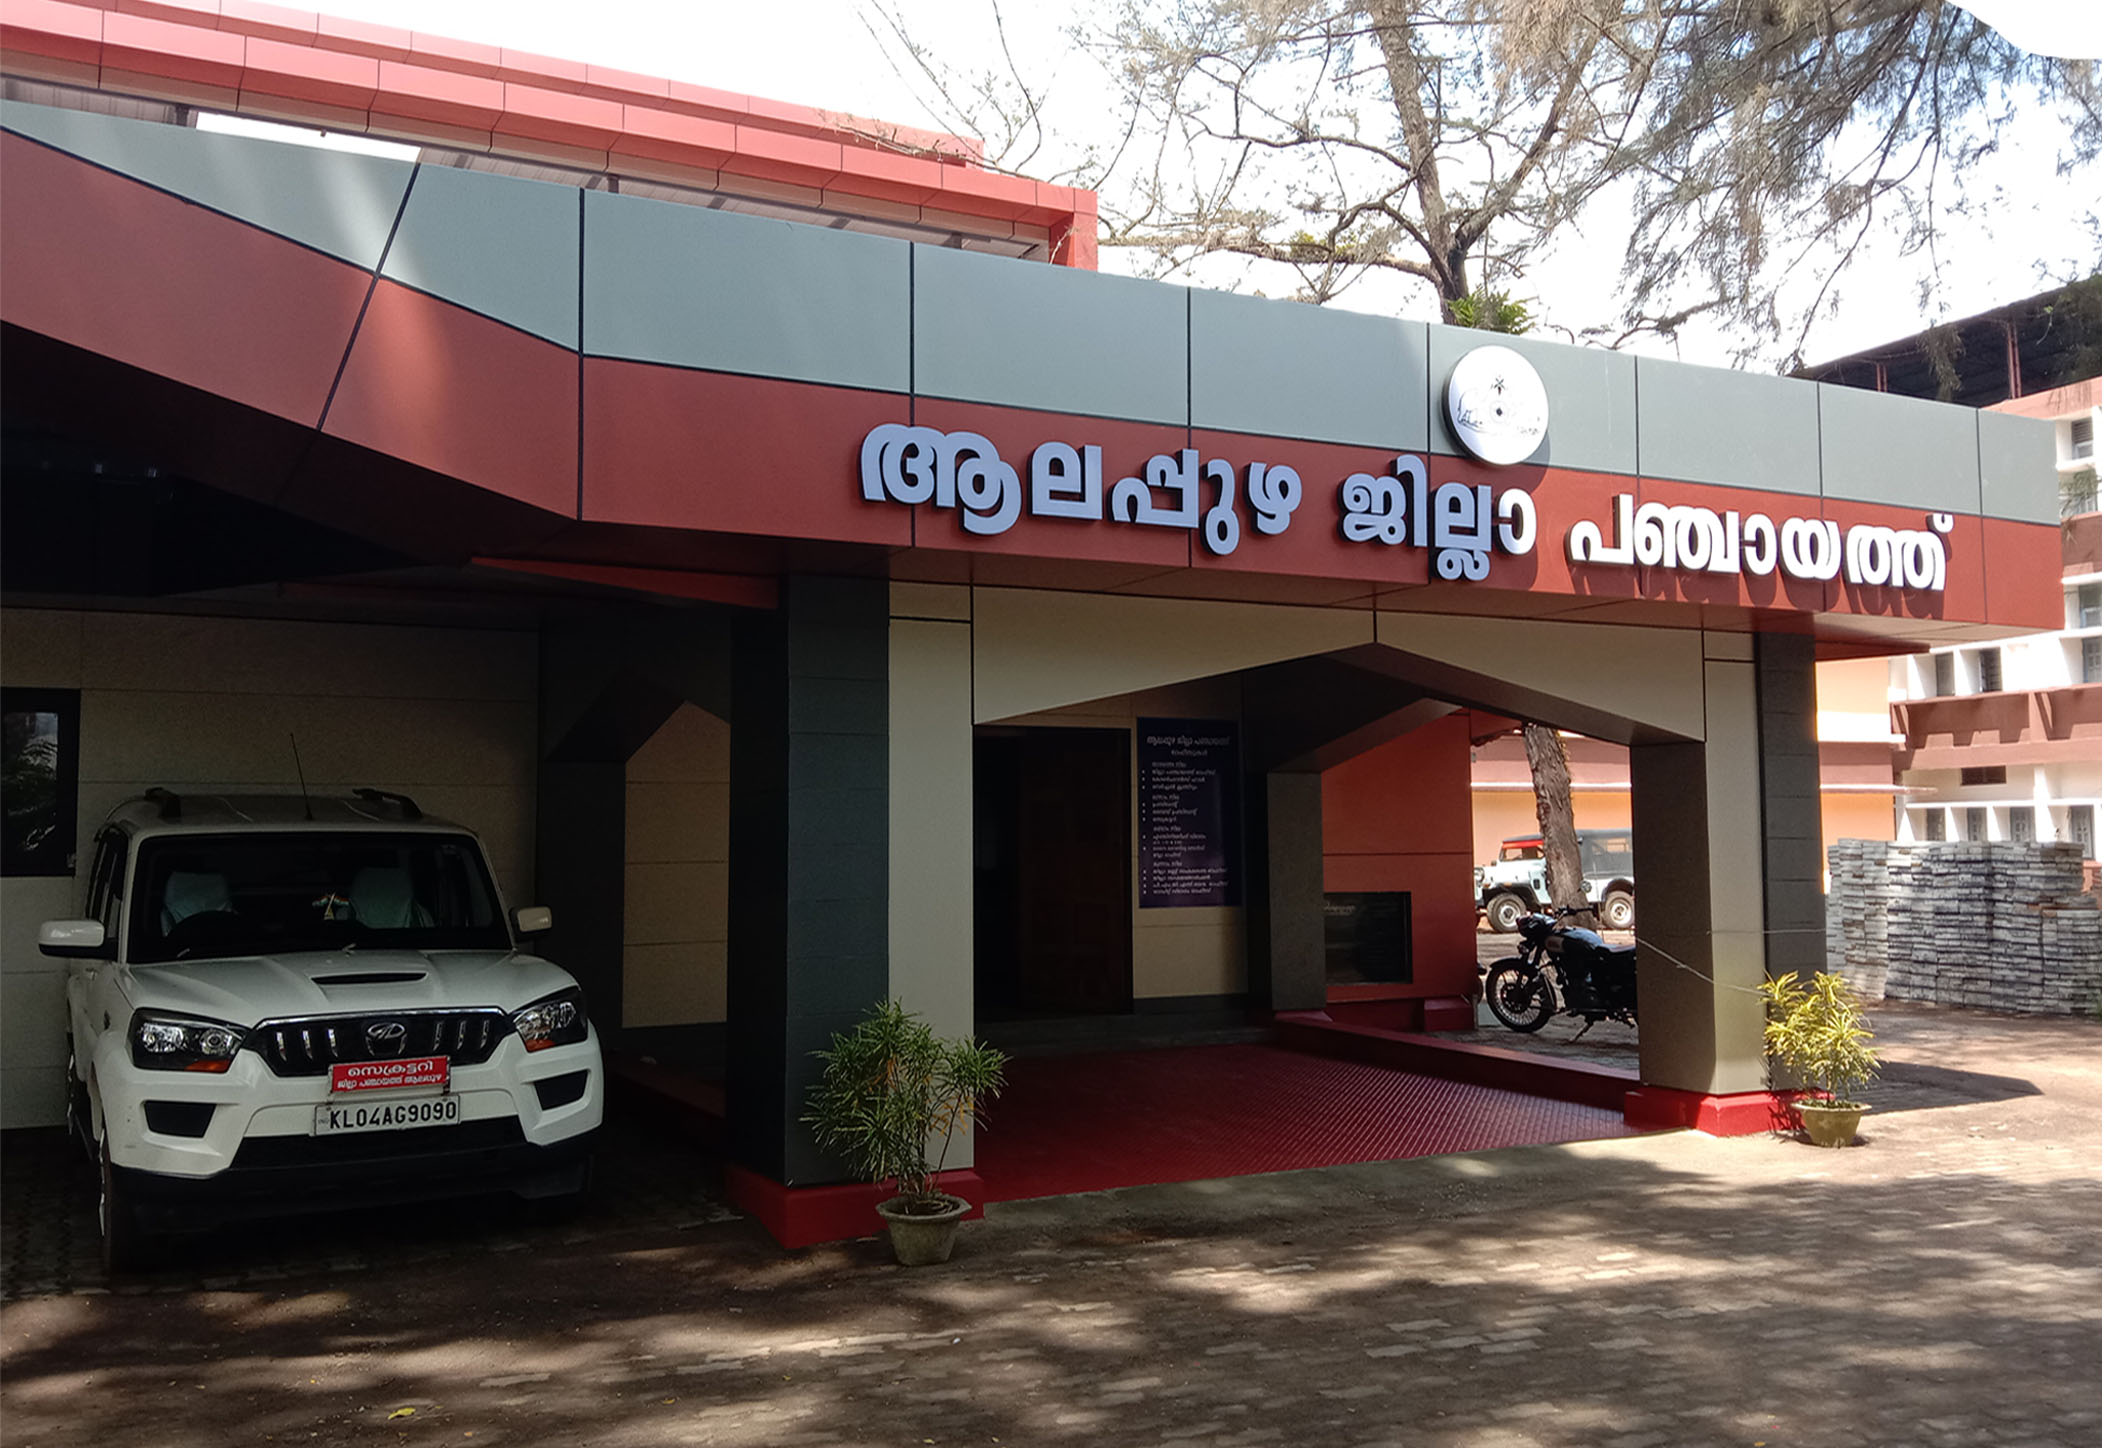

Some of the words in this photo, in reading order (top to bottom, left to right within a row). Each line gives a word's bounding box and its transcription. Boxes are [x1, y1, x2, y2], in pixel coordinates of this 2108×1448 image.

[861, 423, 1302, 556] ആലപ്പുഴ
[1340, 454, 1537, 581] ജില്ലാ
[1569, 493, 1954, 591] പഞ്ചായത്ത്
[347, 1060, 433, 1077] സെക്രട്ടറി
[330, 1101, 457, 1129] KL04AG9090
